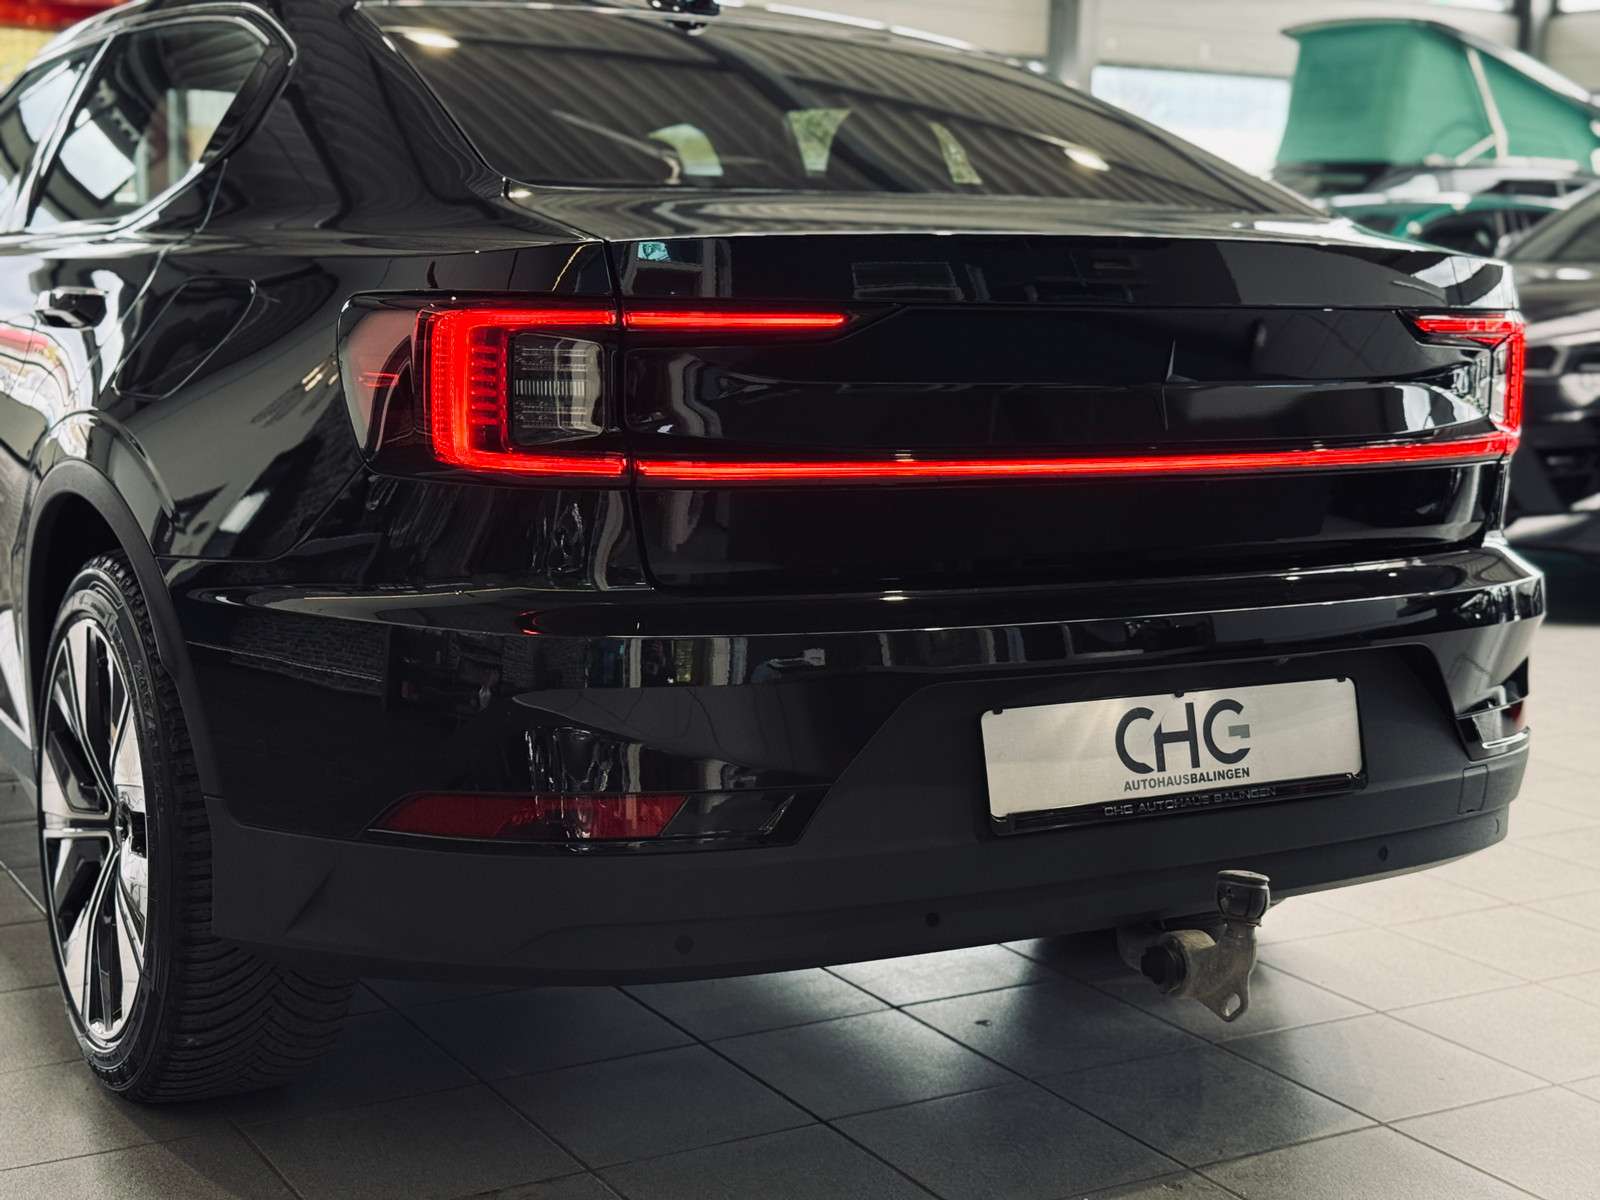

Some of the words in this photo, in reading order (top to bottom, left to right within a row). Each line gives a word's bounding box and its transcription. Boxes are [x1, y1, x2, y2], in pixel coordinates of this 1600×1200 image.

[1115, 699, 1251, 774] CHG
[1124, 767, 1251, 792] AUTOHAUSBALINGEN
[1104, 803, 1134, 816] CHG
[1137, 795, 1210, 813] AUTOHAUS
[1213, 786, 1277, 803] BALINGEN
